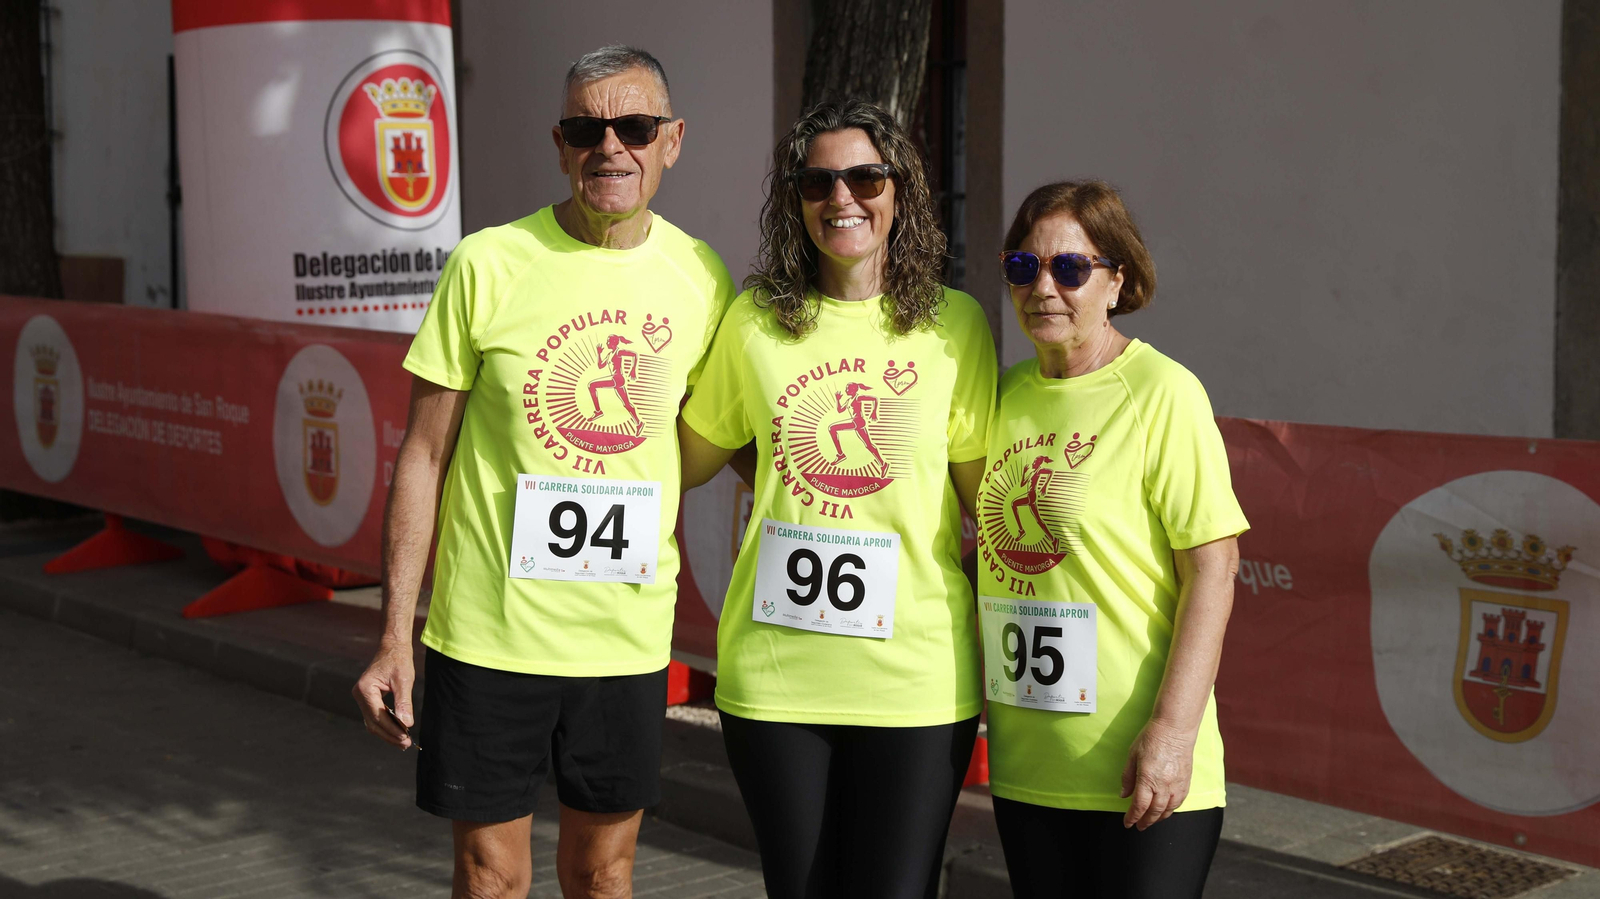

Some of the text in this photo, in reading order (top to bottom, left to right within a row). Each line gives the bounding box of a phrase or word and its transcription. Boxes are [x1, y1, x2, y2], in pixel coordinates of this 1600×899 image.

[294, 248, 411, 278] Delegación
[415, 248, 433, 273] de
[296, 283, 345, 301] Ilustre
[523, 309, 627, 475] VII CARRERA POPULAR
[215, 395, 250, 427] Roque
[566, 431, 635, 453] PUENTE MAYORGA
[771, 358, 866, 519] VII CARRERA POPULAR
[984, 433, 1057, 484] POPULAR
[525, 480, 654, 497] VII CARRERA SOLIDARIA APRON
[811, 477, 880, 496] PUENTE MAYORGA
[548, 500, 629, 560] 94
[766, 525, 892, 548] VII CARRERA SOLIDARIA APRON
[1001, 552, 1055, 573] PUENTE MAYORGA
[786, 548, 866, 611] 96
[1009, 576, 1036, 596] VII
[984, 602, 1089, 619] VII CARRERA SOLIDARIA APRON
[1002, 622, 1065, 686] 95
